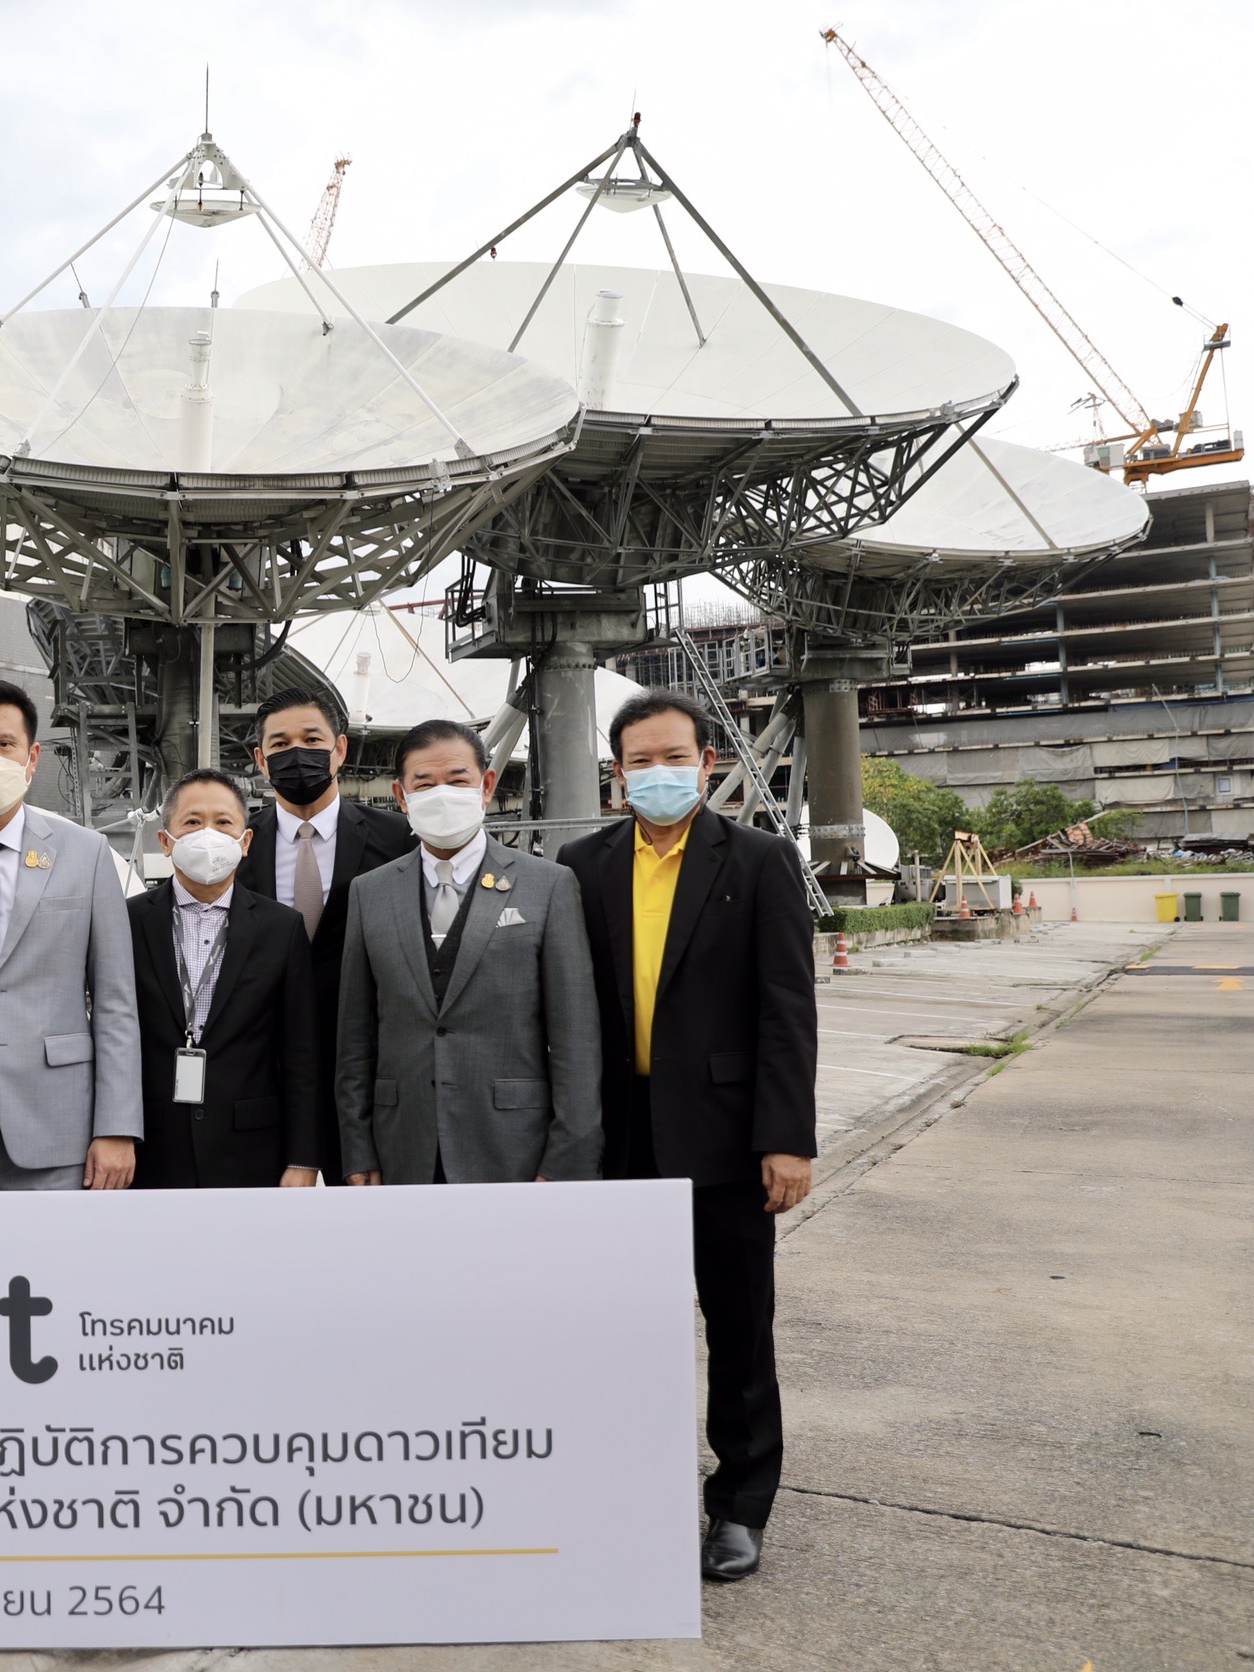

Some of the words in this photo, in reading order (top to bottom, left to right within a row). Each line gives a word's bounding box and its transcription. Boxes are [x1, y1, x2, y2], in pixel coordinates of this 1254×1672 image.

[78, 1311, 234, 1337] โทรคมนาคม
[79, 1344, 184, 1372] แห่งชาติ
[157, 1483, 279, 1528] จำกัด
[298, 1486, 484, 1533] (มหาชน)
[67, 1585, 166, 1616] 2564
